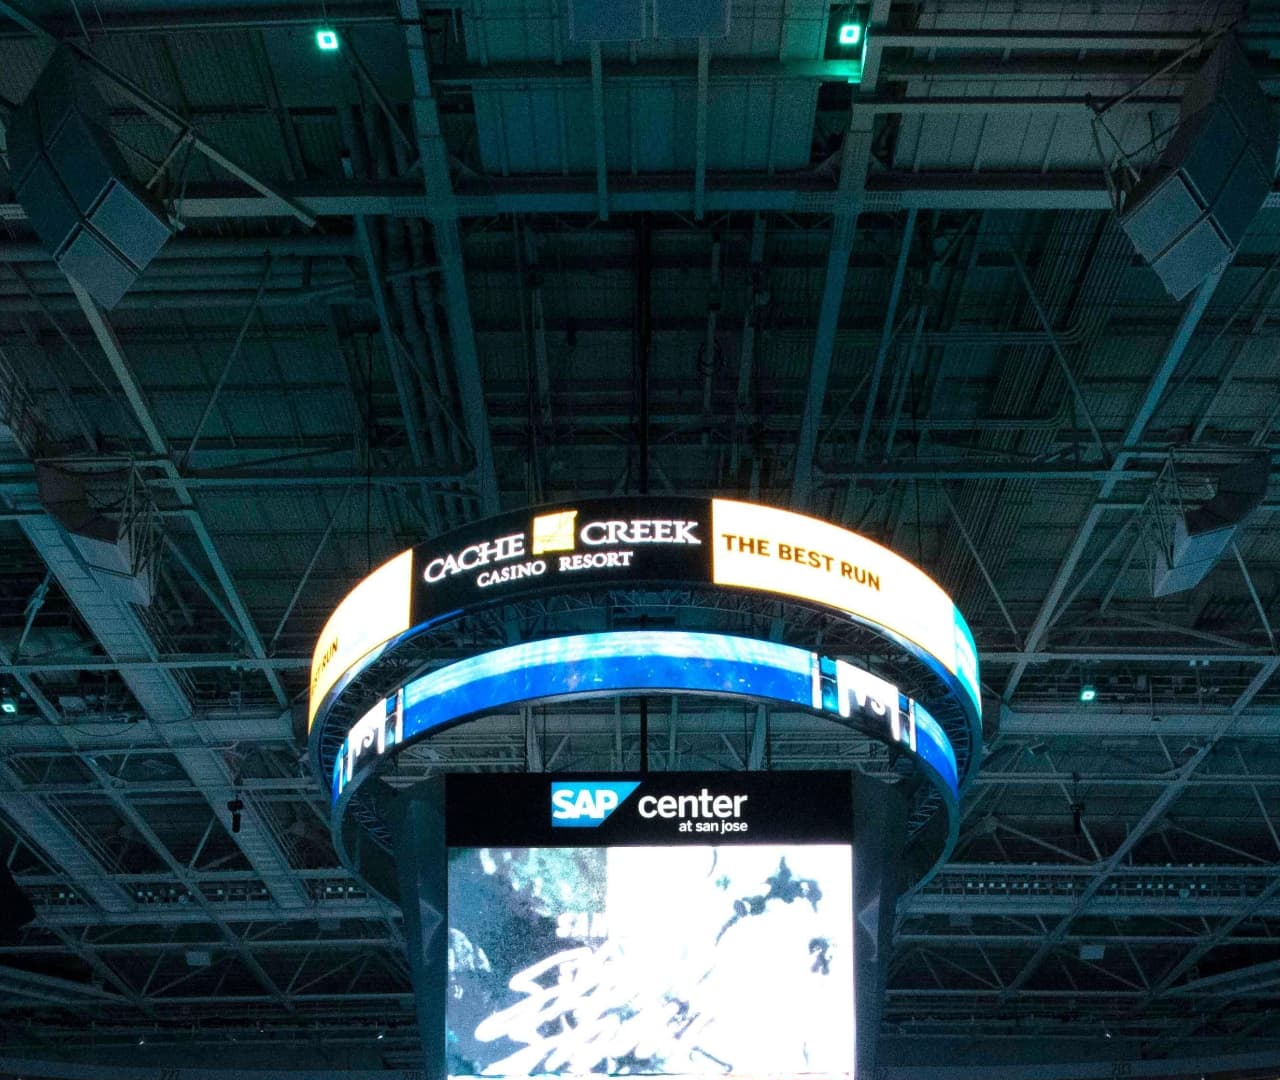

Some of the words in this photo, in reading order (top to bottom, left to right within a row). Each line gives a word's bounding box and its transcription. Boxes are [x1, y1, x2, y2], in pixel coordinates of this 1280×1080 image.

[424, 534, 526, 583] CACHE
[581, 520, 701, 545] CREEK
[477, 560, 546, 588] CASINO
[559, 551, 633, 573] RESORT
[722, 534, 770, 557] THE
[778, 544, 833, 573] BEST
[841, 562, 881, 592] RUN
[552, 790, 619, 819] SAP
[638, 788, 749, 818] center
[678, 820, 692, 832] at
[695, 821, 719, 832] san
[720, 820, 748, 834] jose
